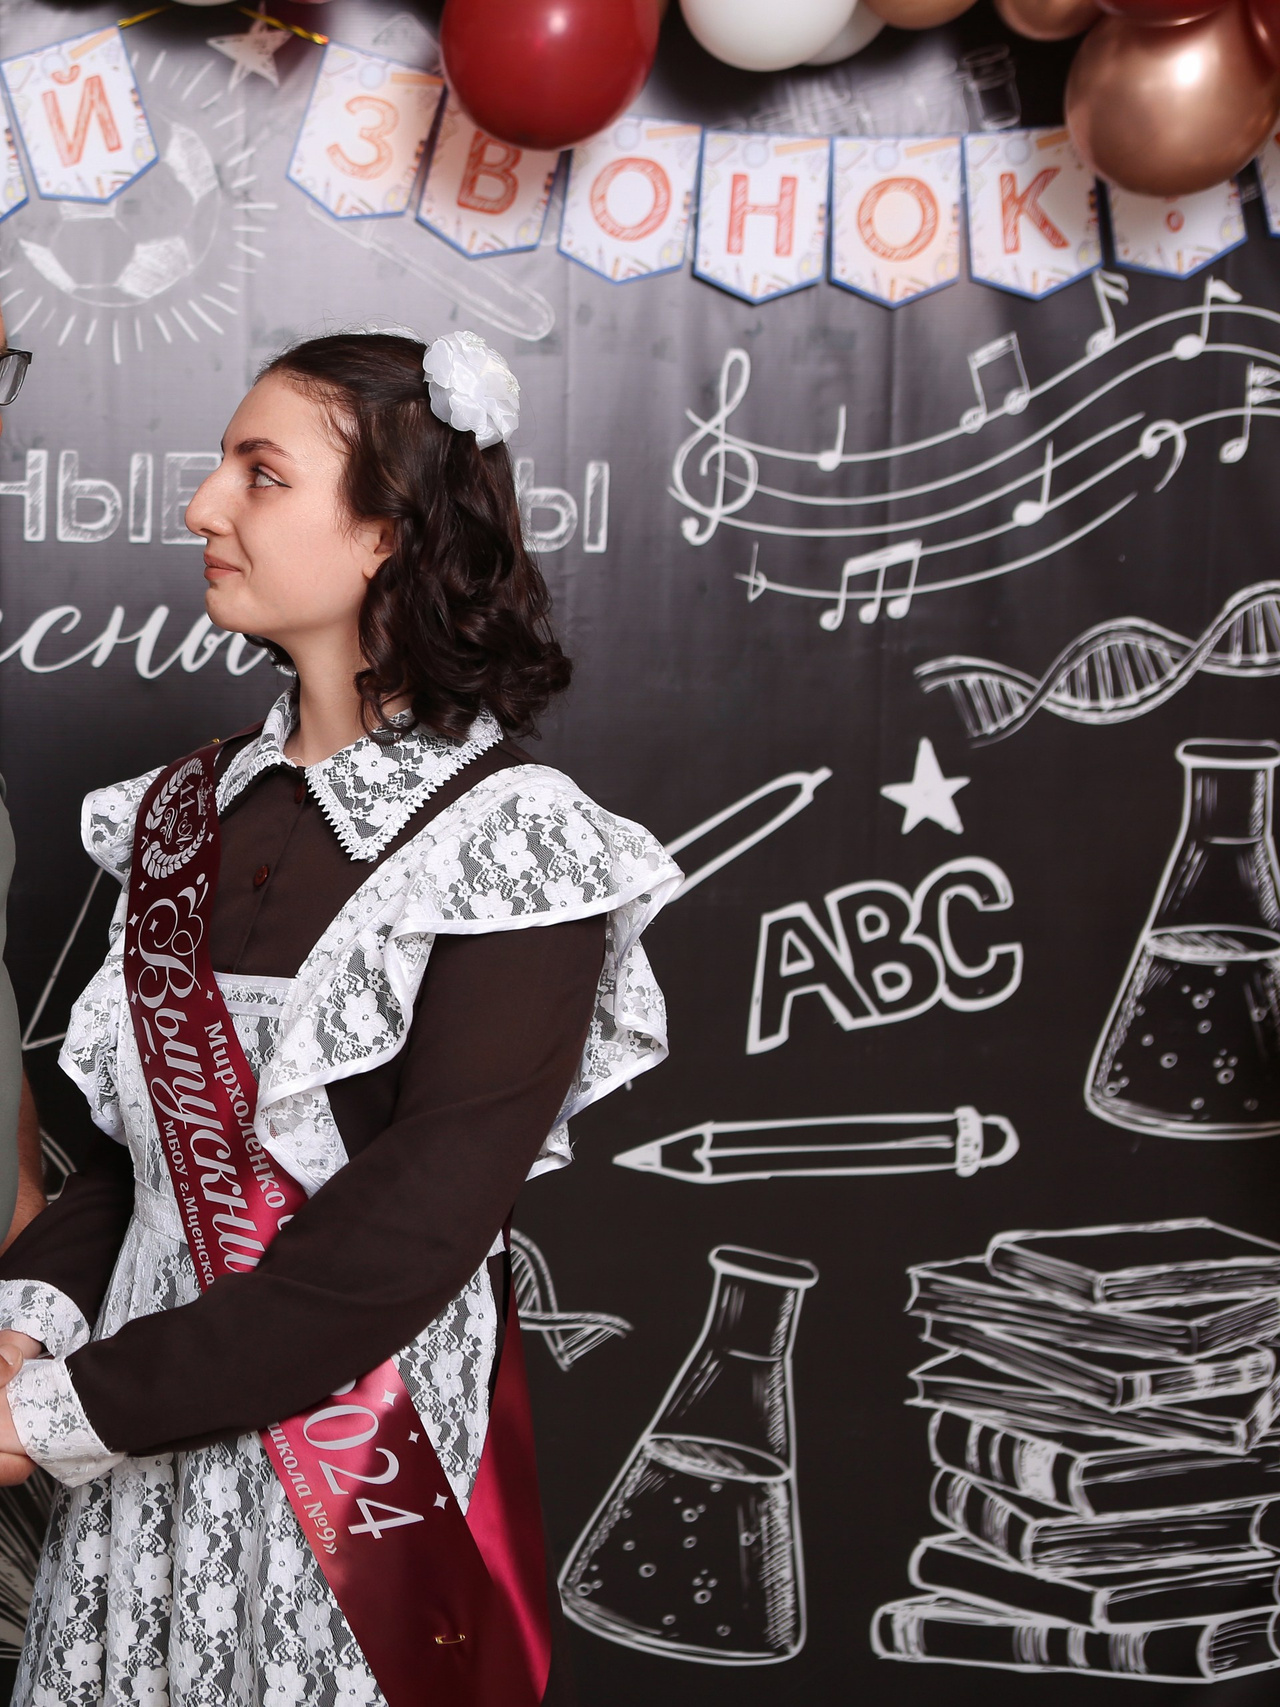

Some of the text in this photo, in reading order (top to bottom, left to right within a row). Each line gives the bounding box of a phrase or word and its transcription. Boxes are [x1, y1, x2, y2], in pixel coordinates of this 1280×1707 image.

[326, 95, 1185, 262] ЗВОНОК
[180, 781, 196, 813] 11
[746, 857, 1023, 1055] ABC
[163, 1120, 189, 1176] МБОУ
[204, 1020, 286, 1208] Мирхоленко
[138, 874, 425, 1540] Выпускни 024
